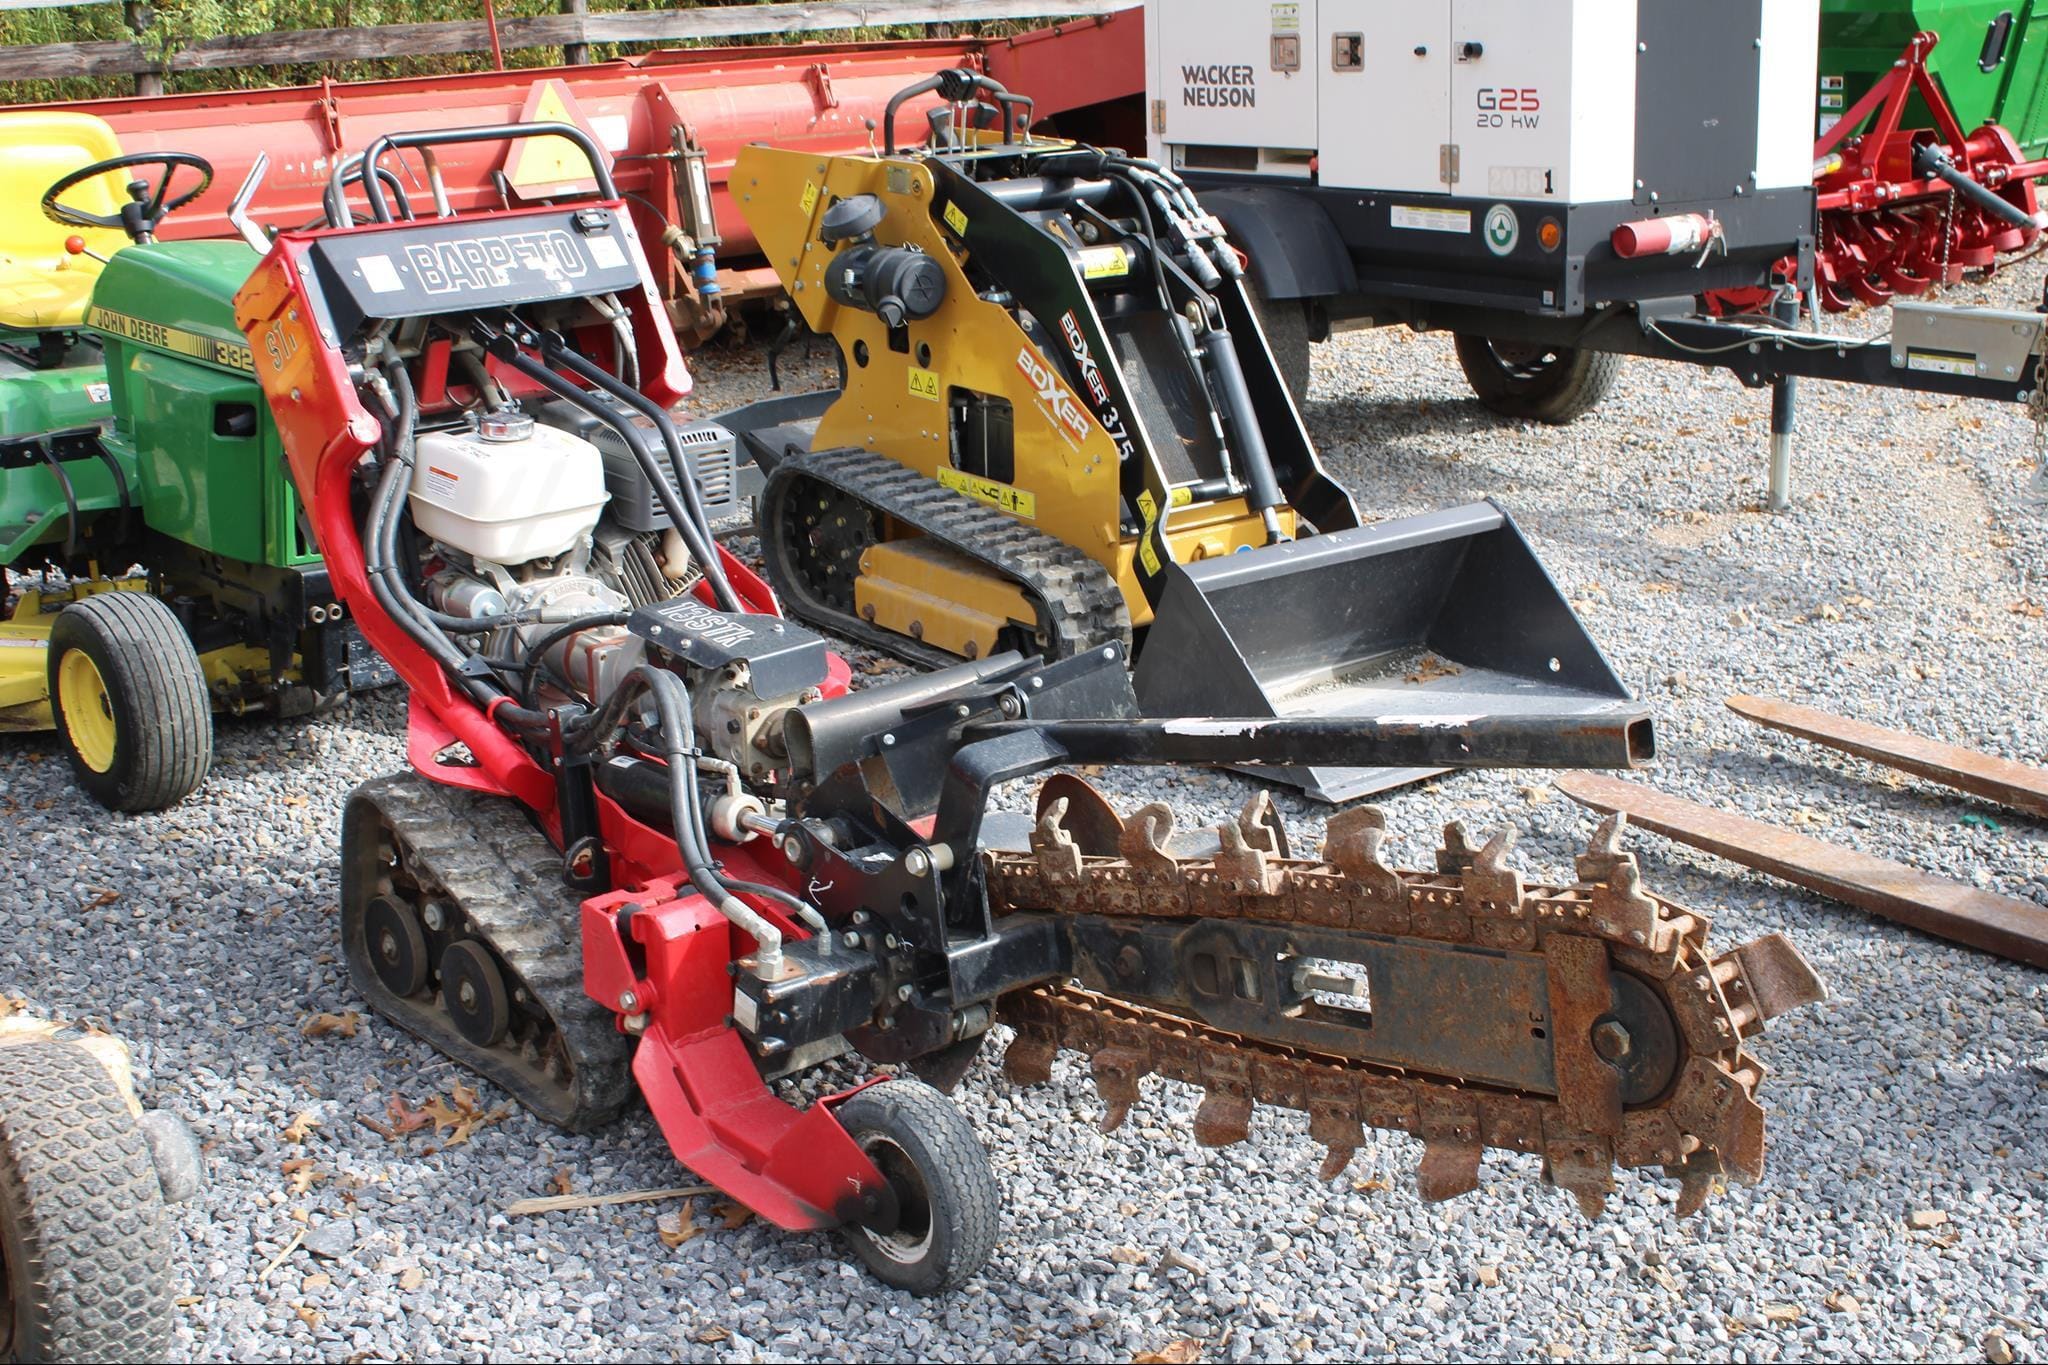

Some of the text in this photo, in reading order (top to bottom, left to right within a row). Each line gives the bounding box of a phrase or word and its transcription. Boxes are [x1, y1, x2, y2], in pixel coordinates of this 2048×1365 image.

[1181, 65, 1255, 85] WACKER
[1183, 87, 1255, 108] NEUSON
[1477, 88, 1540, 111] G25
[1477, 114, 1503, 128] 20
[97, 310, 254, 371] JOHN DEERE 332
[1017, 348, 1091, 440] BOXER
[1061, 312, 1135, 461] BOXER 375
[658, 601, 755, 648] 13STK
